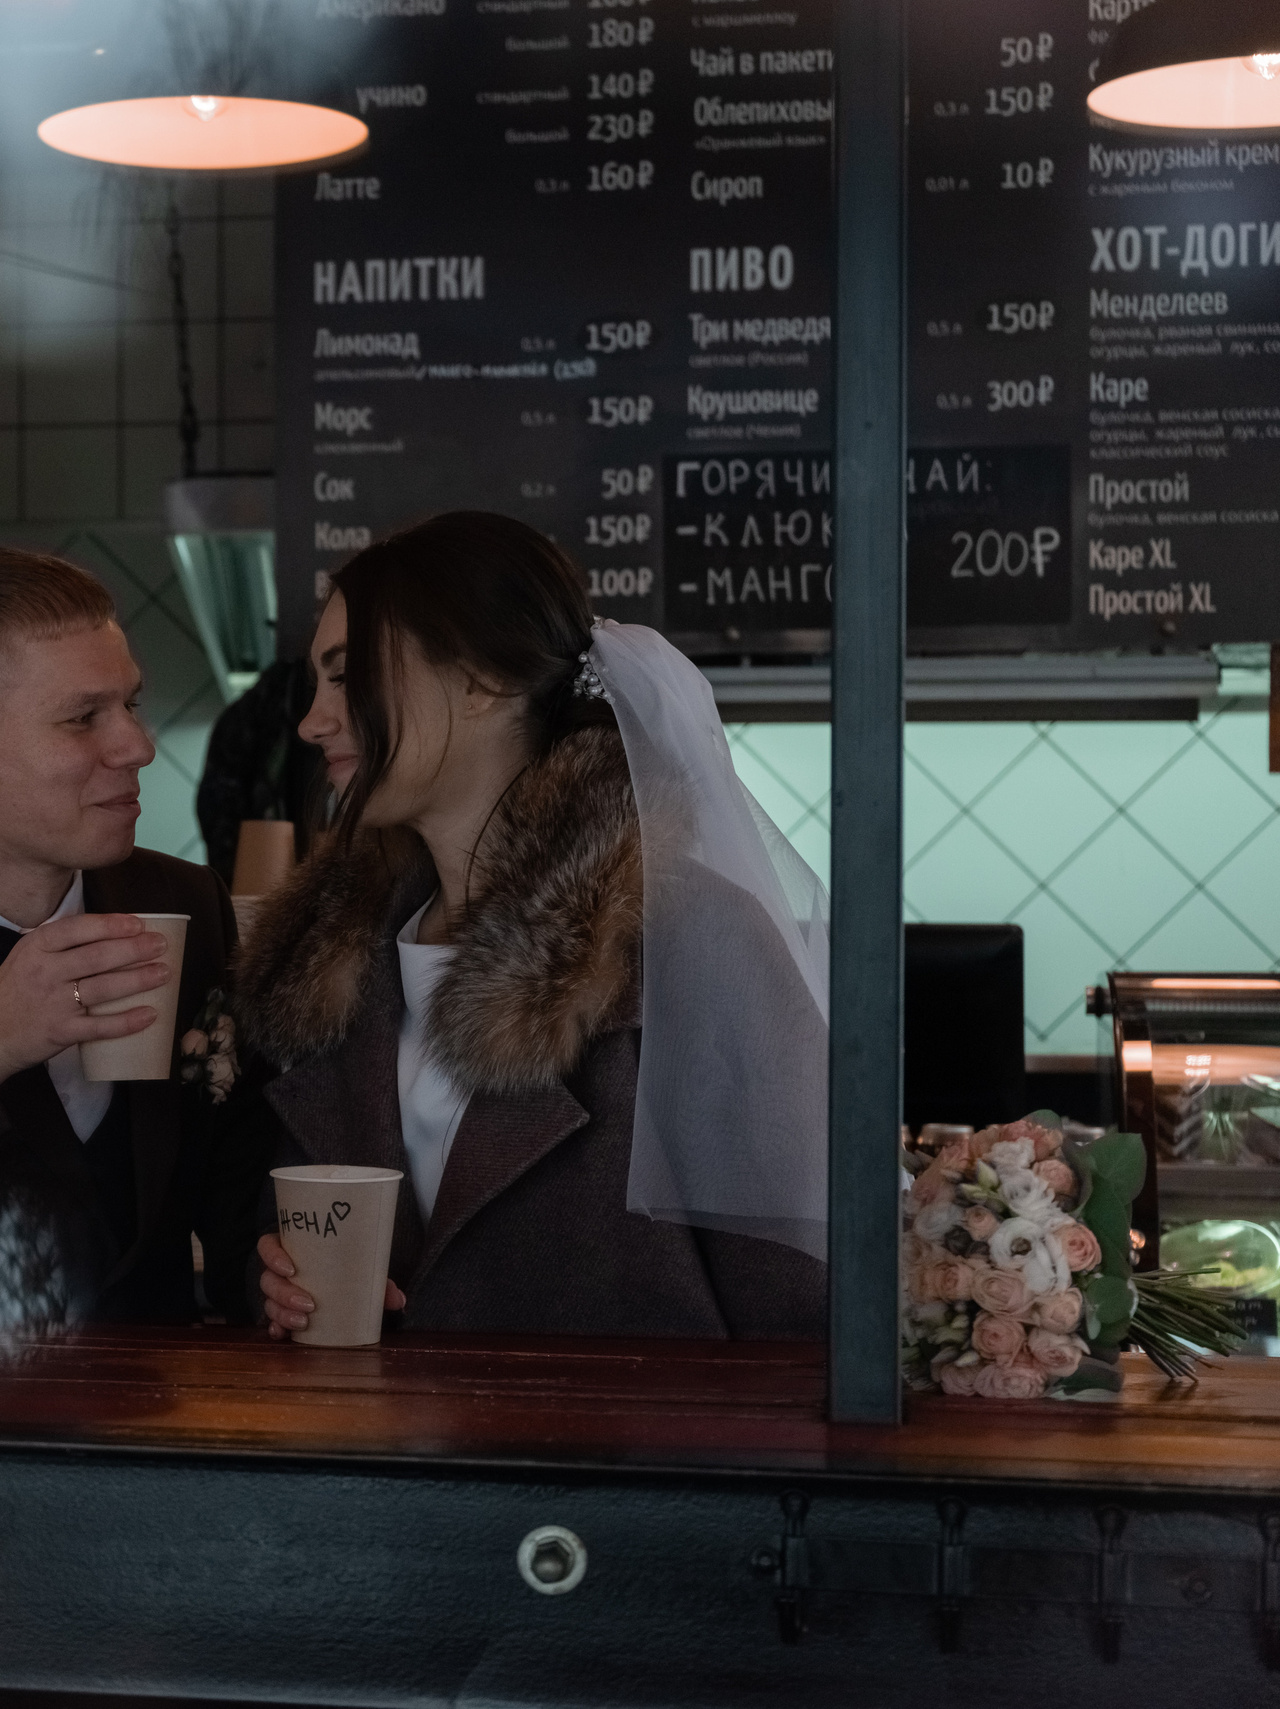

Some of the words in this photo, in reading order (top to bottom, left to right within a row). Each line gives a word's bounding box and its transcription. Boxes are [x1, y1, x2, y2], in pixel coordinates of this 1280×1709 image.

[587, 17, 654, 49] 180₽
[1000, 32, 1053, 67] 50₽
[690, 47, 735, 77] Чай
[739, 53, 755, 75] в
[356, 84, 427, 113] учино
[587, 69, 654, 100] 140₽
[693, 95, 833, 126] Облепиховы
[985, 81, 1053, 117] 150₽
[587, 109, 654, 143] 230₽
[1088, 138, 1219, 178] Кукурузный
[315, 172, 381, 200] Латте
[587, 160, 654, 192] 160₽
[690, 170, 763, 206] Сироп
[1001, 157, 1054, 190] 10₽
[690, 244, 795, 292] ПИВО
[1089, 221, 1280, 278] ХОТ-ДОГИ
[314, 256, 485, 303] НАПИТКИ
[1089, 288, 1229, 322] Менделеев
[314, 328, 420, 359] Лимонад
[585, 320, 652, 354] 150₽
[688, 313, 728, 350] Три
[987, 301, 1054, 334] 150₽
[687, 384, 819, 421] Крушовице
[987, 374, 1054, 412] 300₽
[1089, 371, 1149, 408] Каре
[315, 403, 372, 436] Морс
[586, 396, 654, 428] 150₽
[314, 472, 356, 502] Сок
[601, 464, 654, 500] 50₽
[676, 457, 832, 500] ГОРЯЧИ
[1089, 471, 1190, 511] Простой
[315, 522, 372, 551] Кола
[585, 513, 652, 547] 150₽
[950, 526, 1061, 578] 200₽
[1089, 538, 1144, 578] Каре
[1149, 537, 1177, 570] XL
[587, 567, 653, 597] 100₽
[1089, 582, 1184, 622] Простой
[1188, 582, 1217, 614] XL
